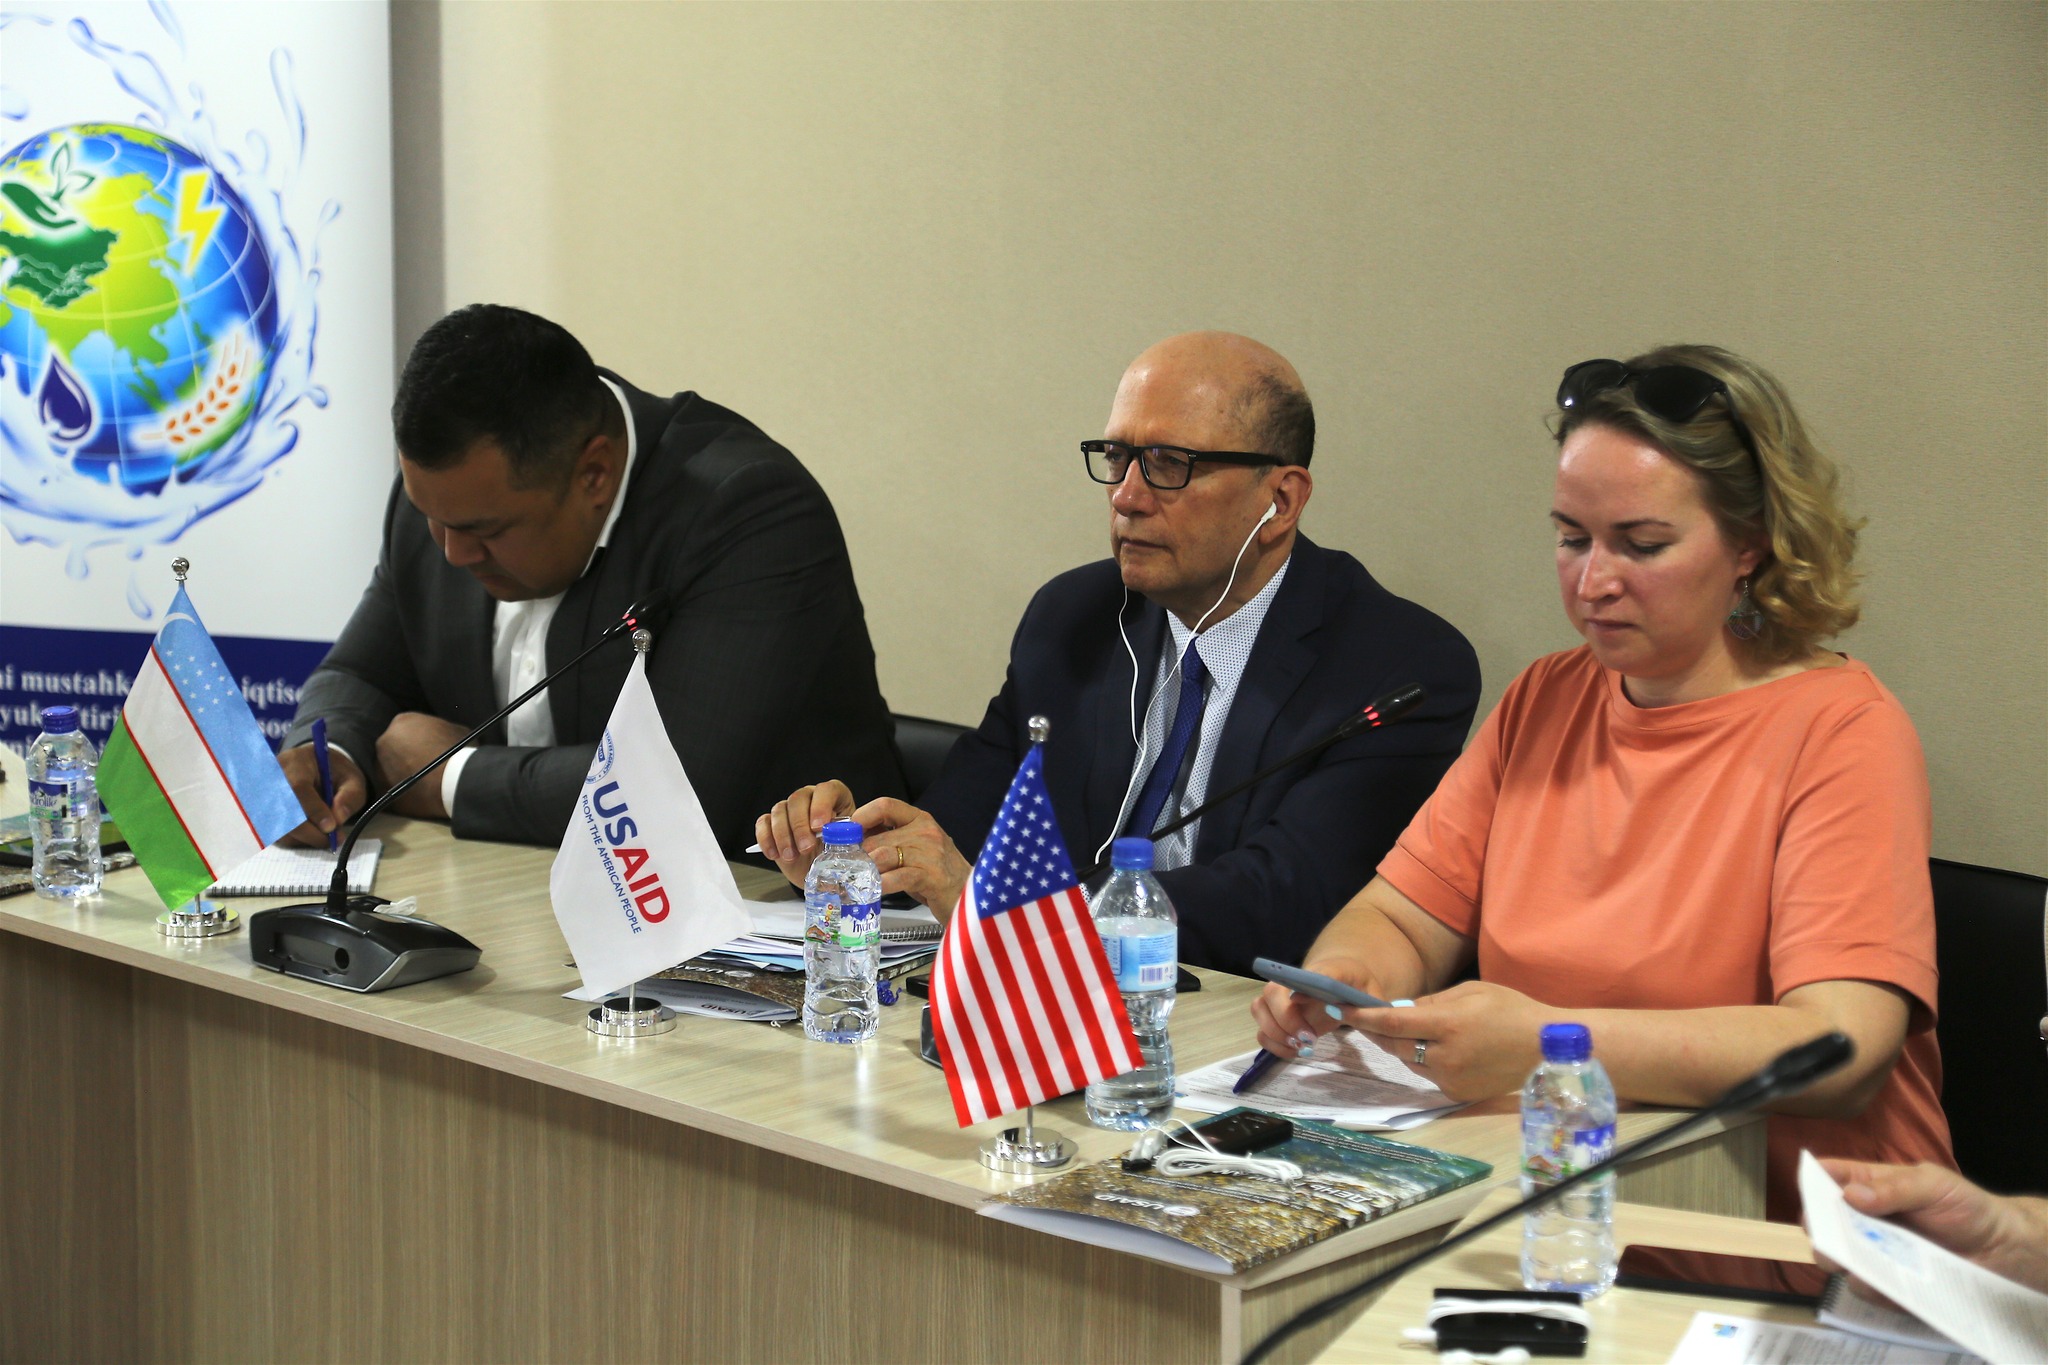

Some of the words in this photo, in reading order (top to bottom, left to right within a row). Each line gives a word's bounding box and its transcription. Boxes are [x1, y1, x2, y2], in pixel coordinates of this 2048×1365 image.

[582, 794, 594, 824] FROM
[589, 821, 603, 846] THE
[598, 847, 626, 898] AMERICAN
[620, 898, 642, 934] PEOPLE
[593, 781, 671, 924] USAID
[1094, 1194, 1164, 1210] USAID
[1310, 1184, 1373, 1203] ДЕНЬ
